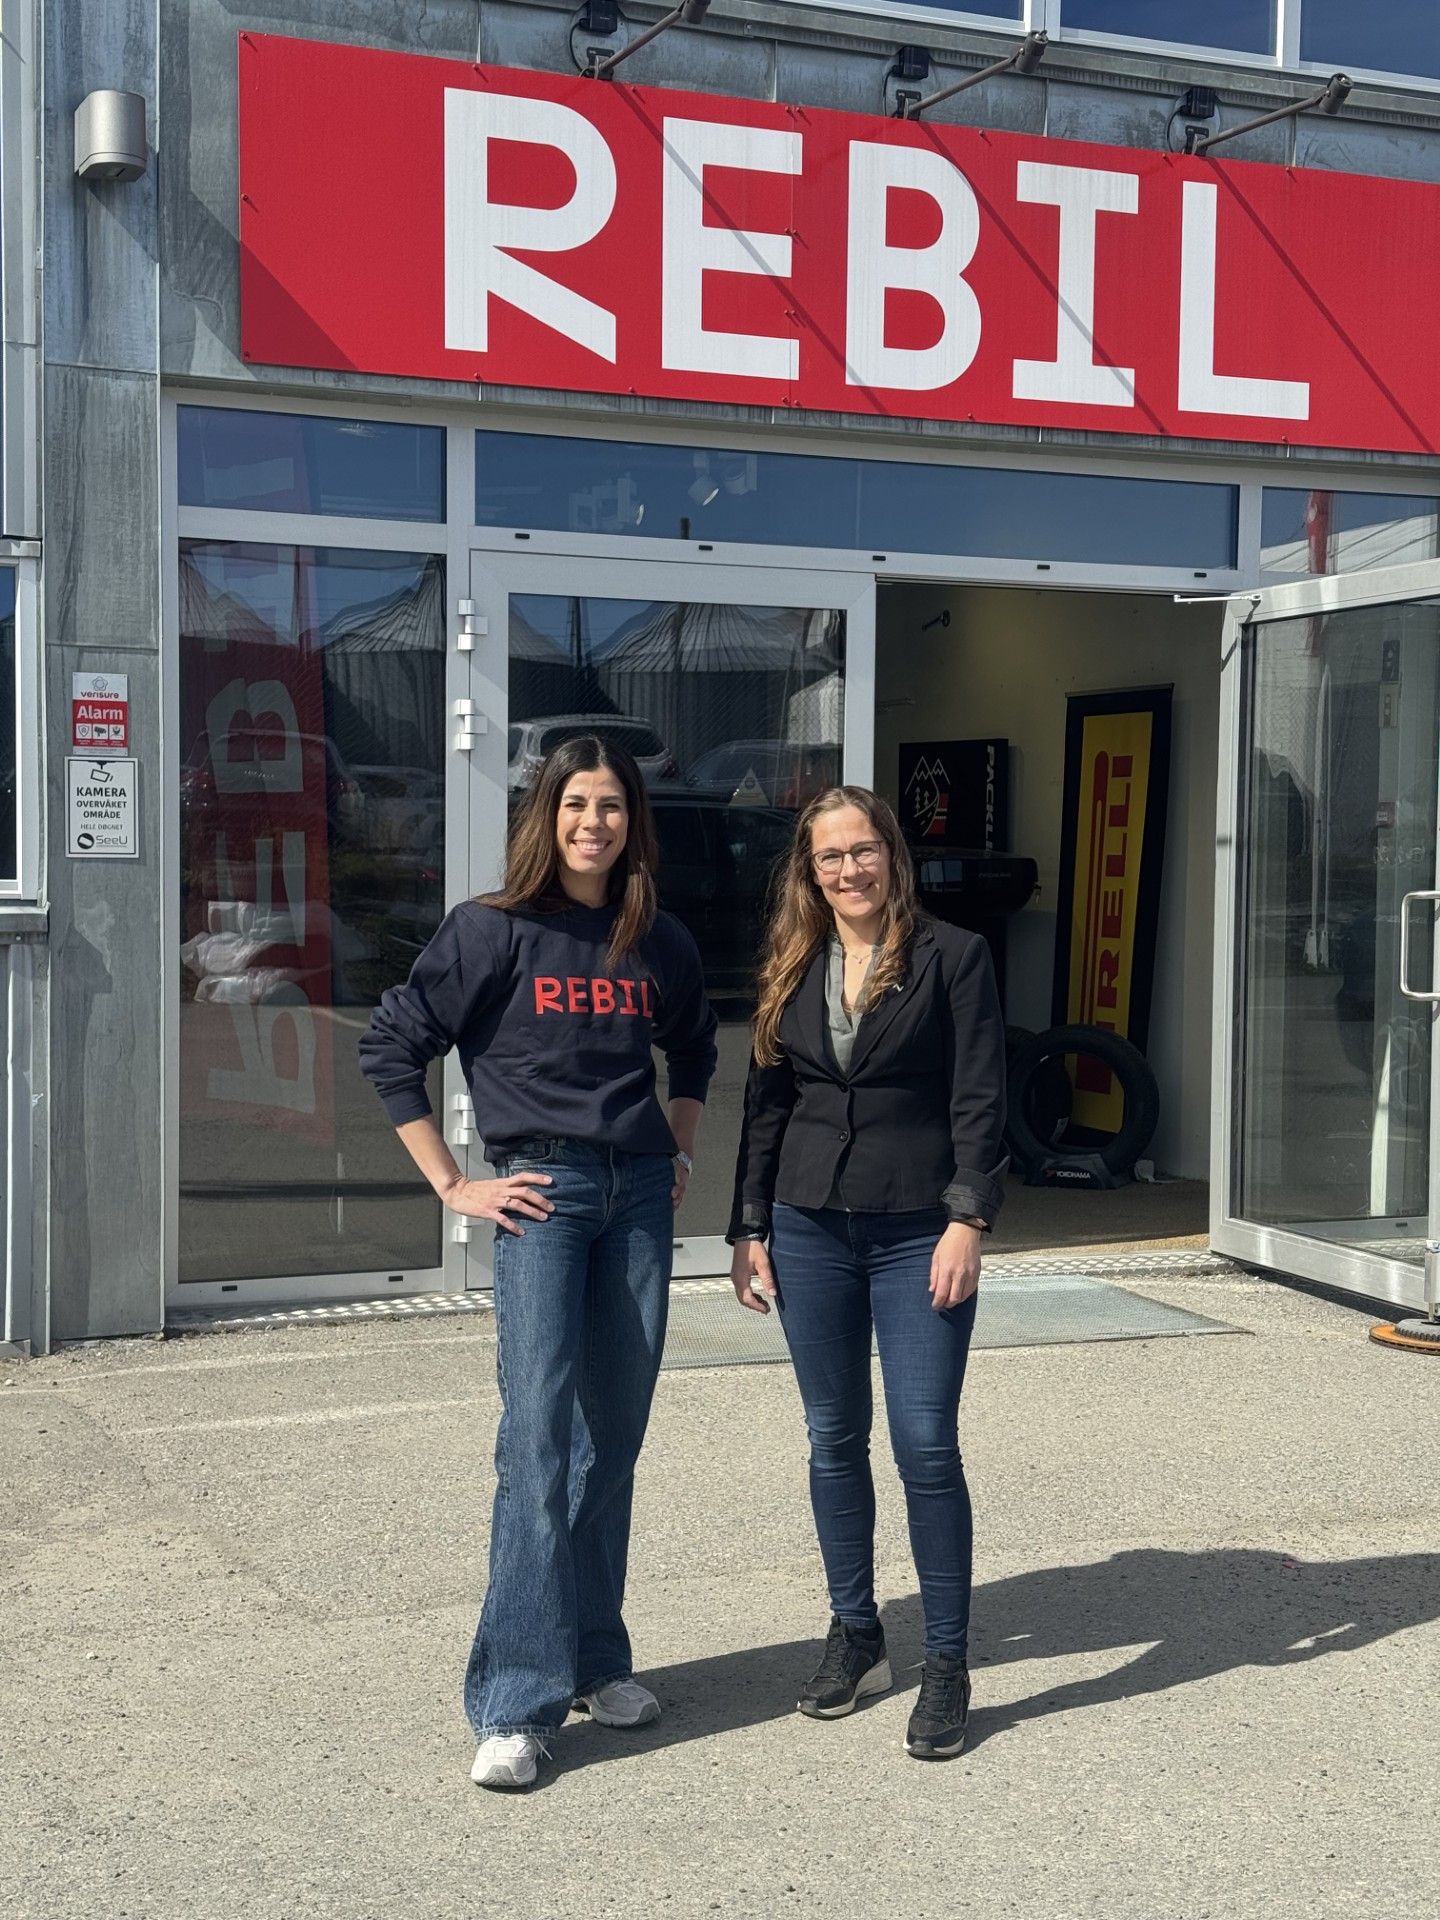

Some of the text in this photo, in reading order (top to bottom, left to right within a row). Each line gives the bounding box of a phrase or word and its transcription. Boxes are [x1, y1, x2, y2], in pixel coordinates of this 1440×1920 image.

[444, 87, 1310, 421] REBIL
[77, 705, 123, 720] Alarm
[76, 787, 127, 797] KAMERA
[76, 799, 127, 808] OVERVÅKET
[83, 809, 121, 818] OMRÅDE
[96, 835, 128, 845] SeeU
[534, 976, 653, 1018] REBIL
